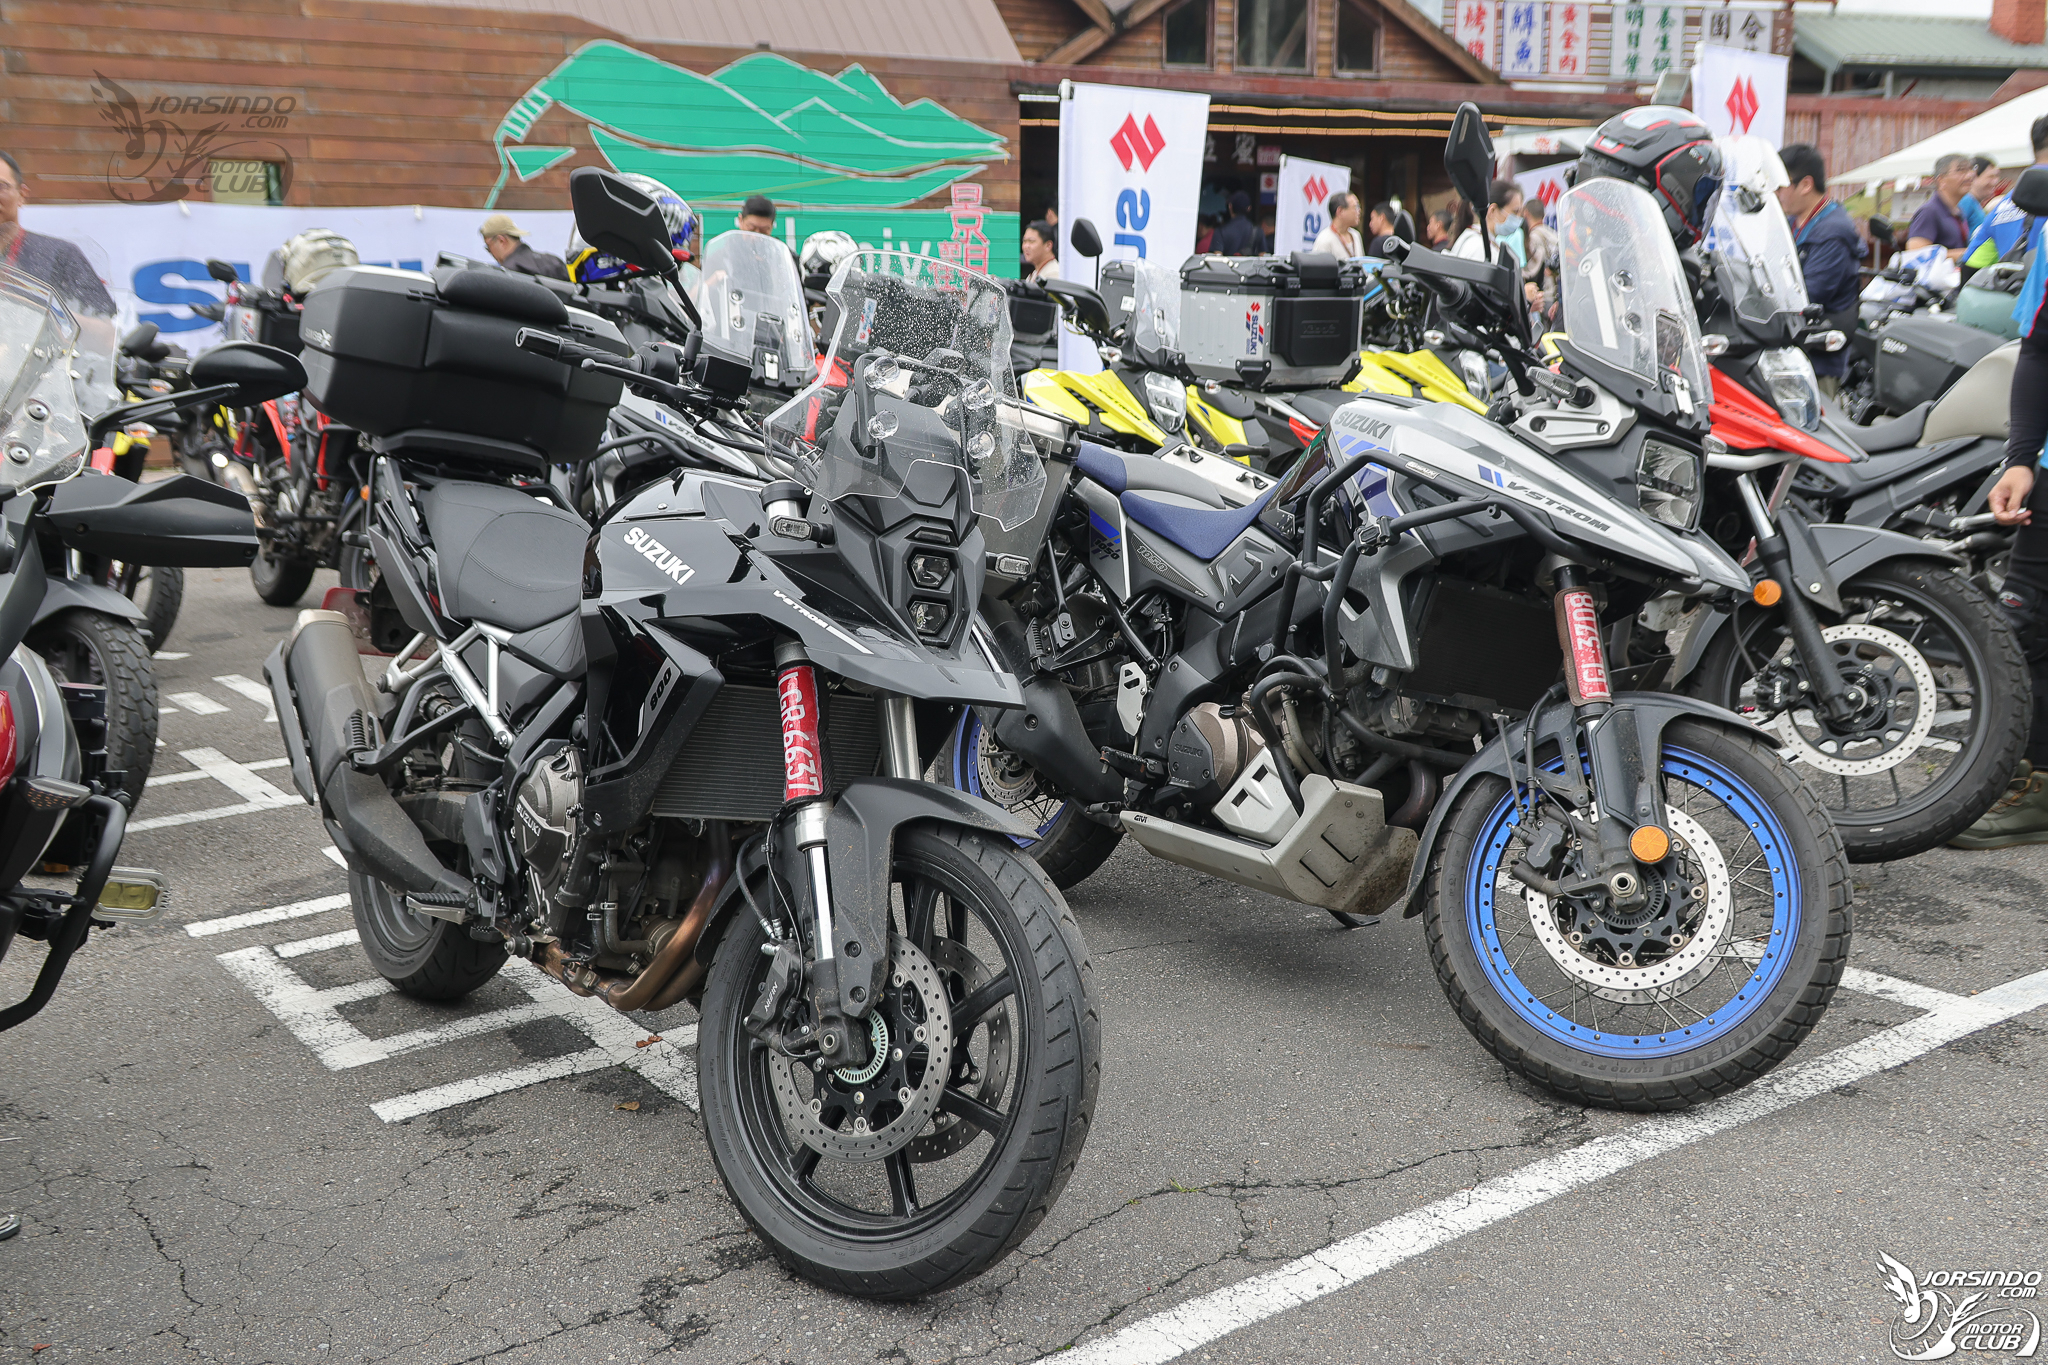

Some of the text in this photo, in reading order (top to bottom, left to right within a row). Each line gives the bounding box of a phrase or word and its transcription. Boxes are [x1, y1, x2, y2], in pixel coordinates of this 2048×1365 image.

[1739, 10, 1767, 51] 合
[1250, 314, 1259, 355] SUZUKI
[1335, 411, 1392, 440] SUZUKI
[1507, 481, 1611, 532] V-STROM
[623, 526, 696, 585] SUZUKI
[1094, 538, 1120, 560] 1050
[1137, 545, 1168, 572] 1050
[773, 590, 828, 628] V-STROM
[649, 667, 673, 709] 800
[1174, 744, 1203, 758] SUZUKI
[516, 803, 541, 836] SUZUKI
[1134, 815, 1148, 823] GIVI
[1671, 1010, 1774, 1074] MICHELIN
